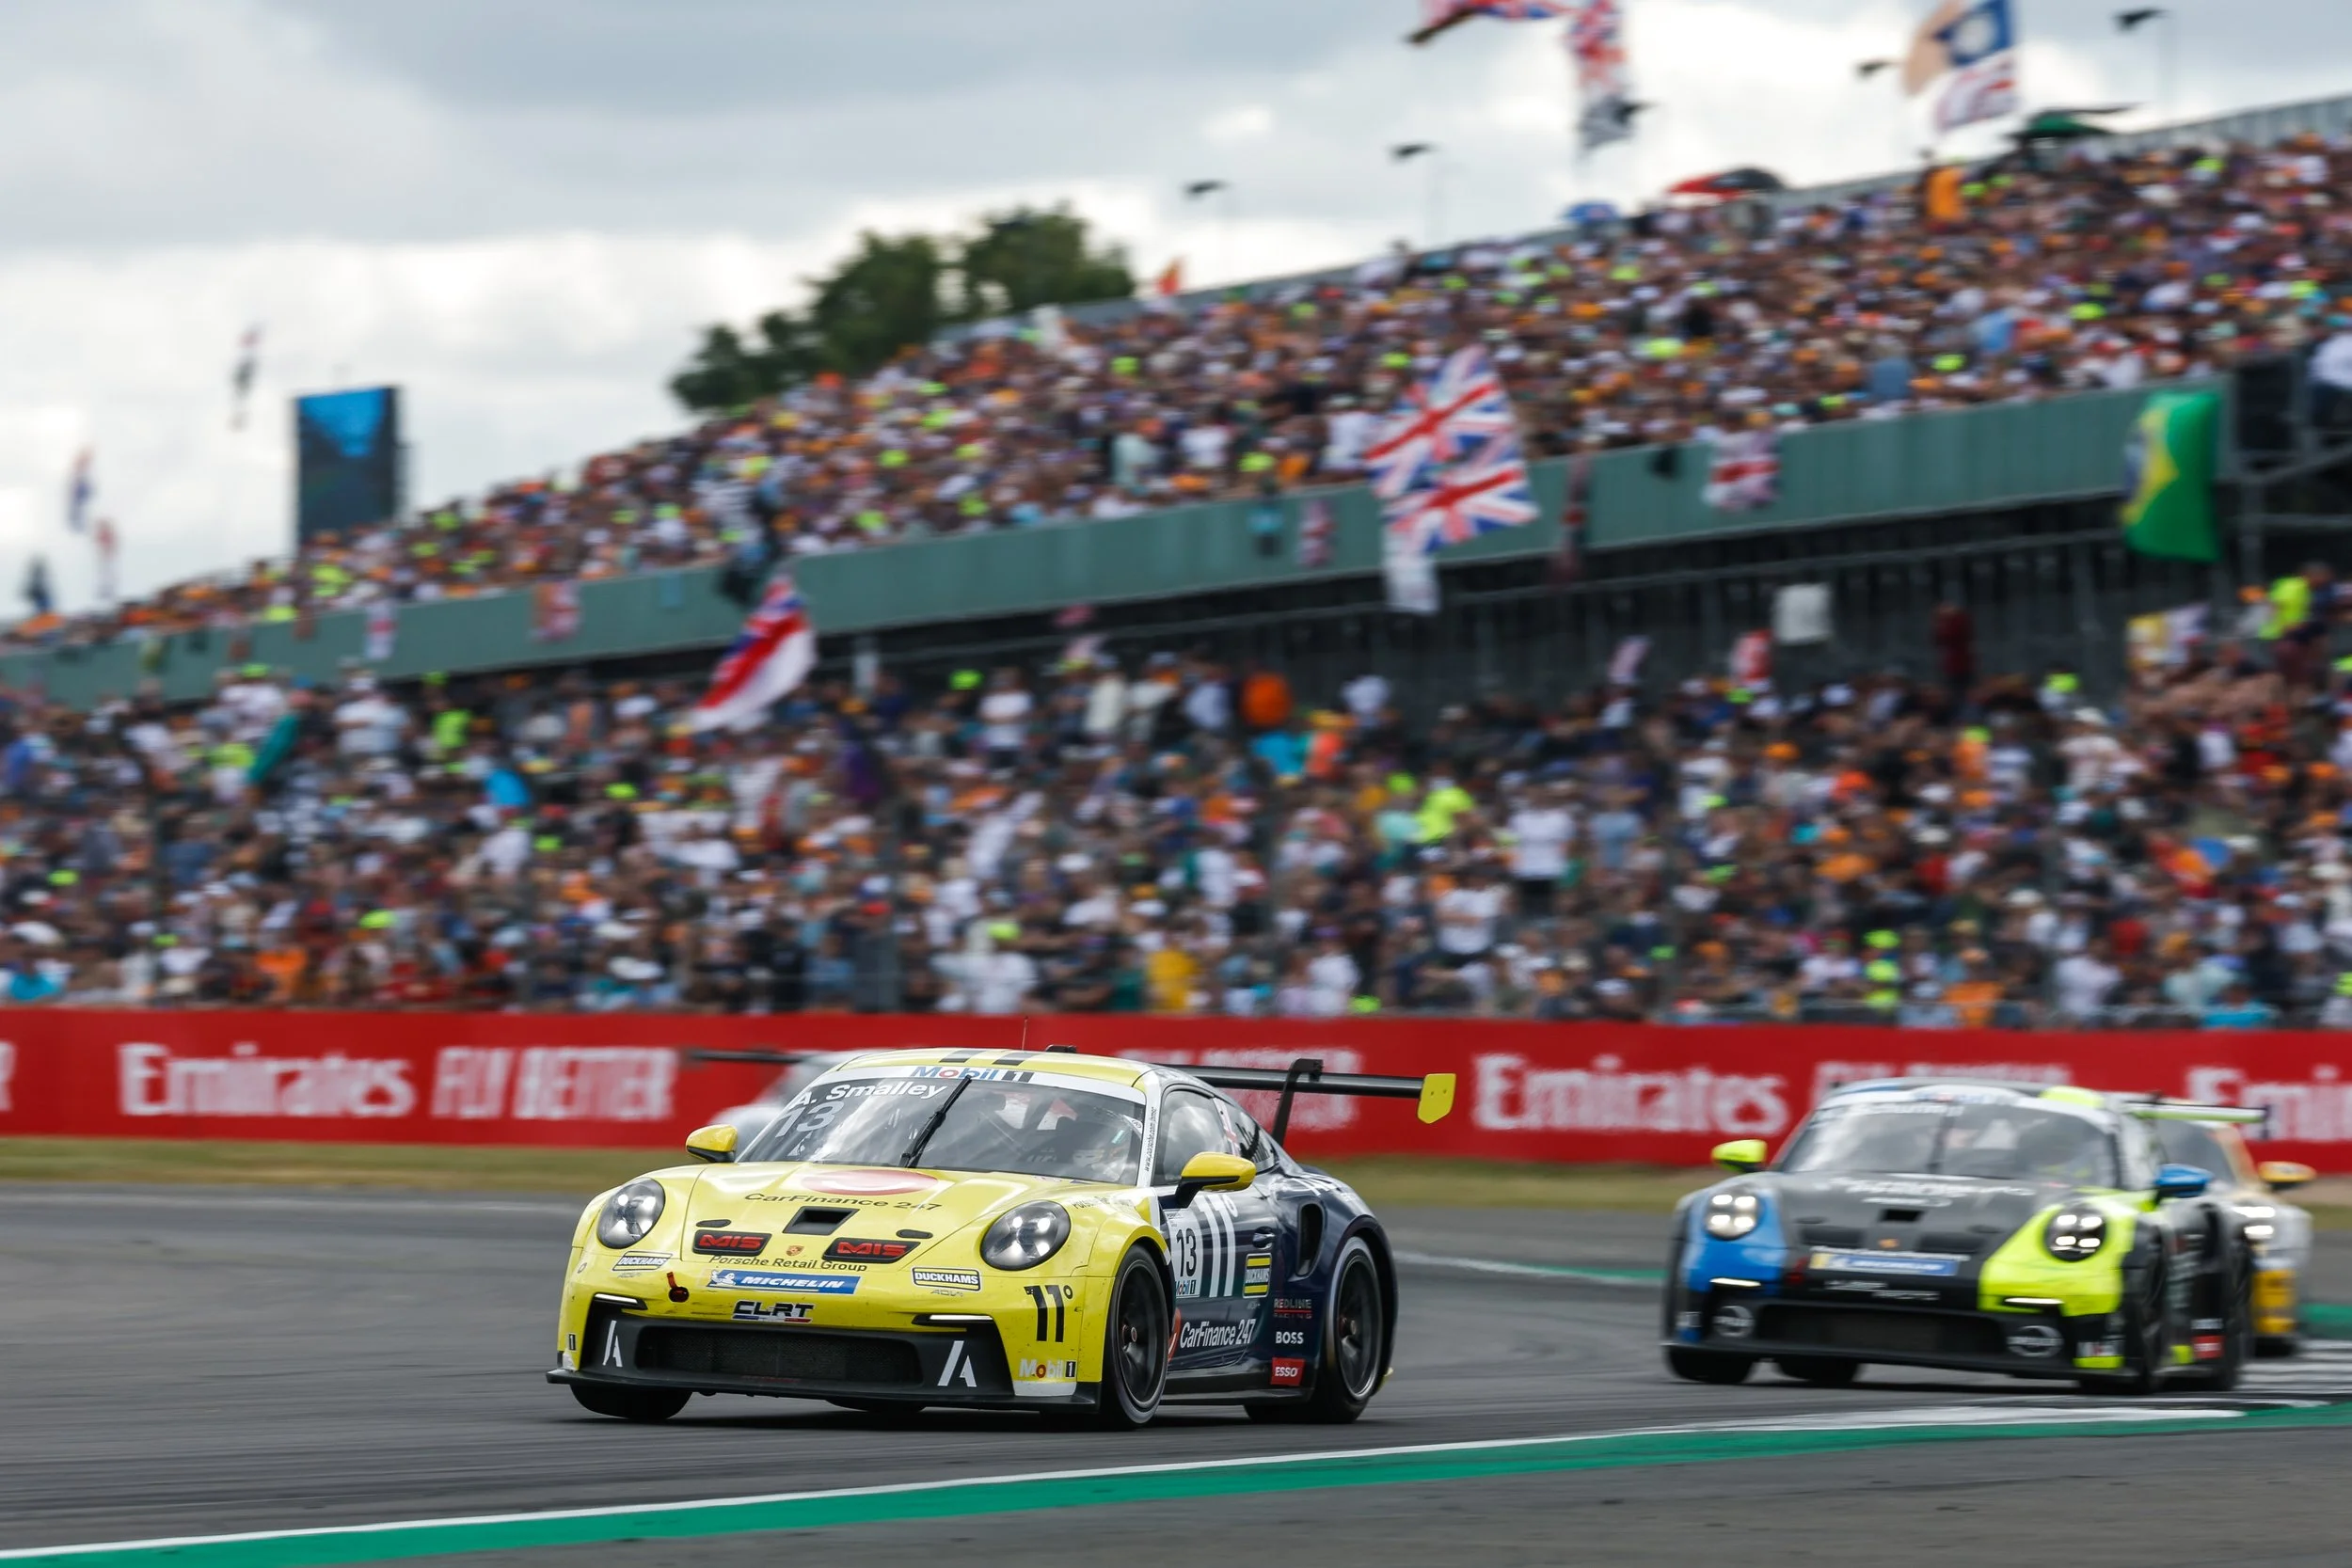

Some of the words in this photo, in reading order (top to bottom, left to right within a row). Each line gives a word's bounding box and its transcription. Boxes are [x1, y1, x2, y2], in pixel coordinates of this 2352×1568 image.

[119, 1042, 416, 1117] Emirates
[910, 1066, 997, 1081] Mobil
[1001, 1070, 1034, 1083] 1
[788, 1091, 817, 1110] A.
[825, 1081, 946, 1100] Smalley
[1474, 1054, 1789, 1134] Emirates
[774, 1101, 844, 1138] 13
[744, 1193, 888, 1207] CarFinance
[893, 1201, 942, 1212] 247
[618, 1257, 668, 1265] DUCKHAMS
[1176, 1227, 1198, 1277] 13
[708, 1254, 770, 1266] Porsche
[772, 1258, 818, 1269] Retail
[819, 1261, 867, 1273] Group
[740, 1275, 845, 1289] MICHELIN
[914, 1272, 978, 1285] DUCKHAMS
[733, 1300, 816, 1319] CLRT
[1274, 1298, 1312, 1309] REDLINE
[1180, 1321, 1236, 1348] CarFinance
[1235, 1319, 1256, 1345] 247
[1276, 1331, 1304, 1344] BOSS
[1019, 1357, 1064, 1378] Mobil
[1065, 1361, 1076, 1377] 1
[1274, 1367, 1298, 1377] ESSO
